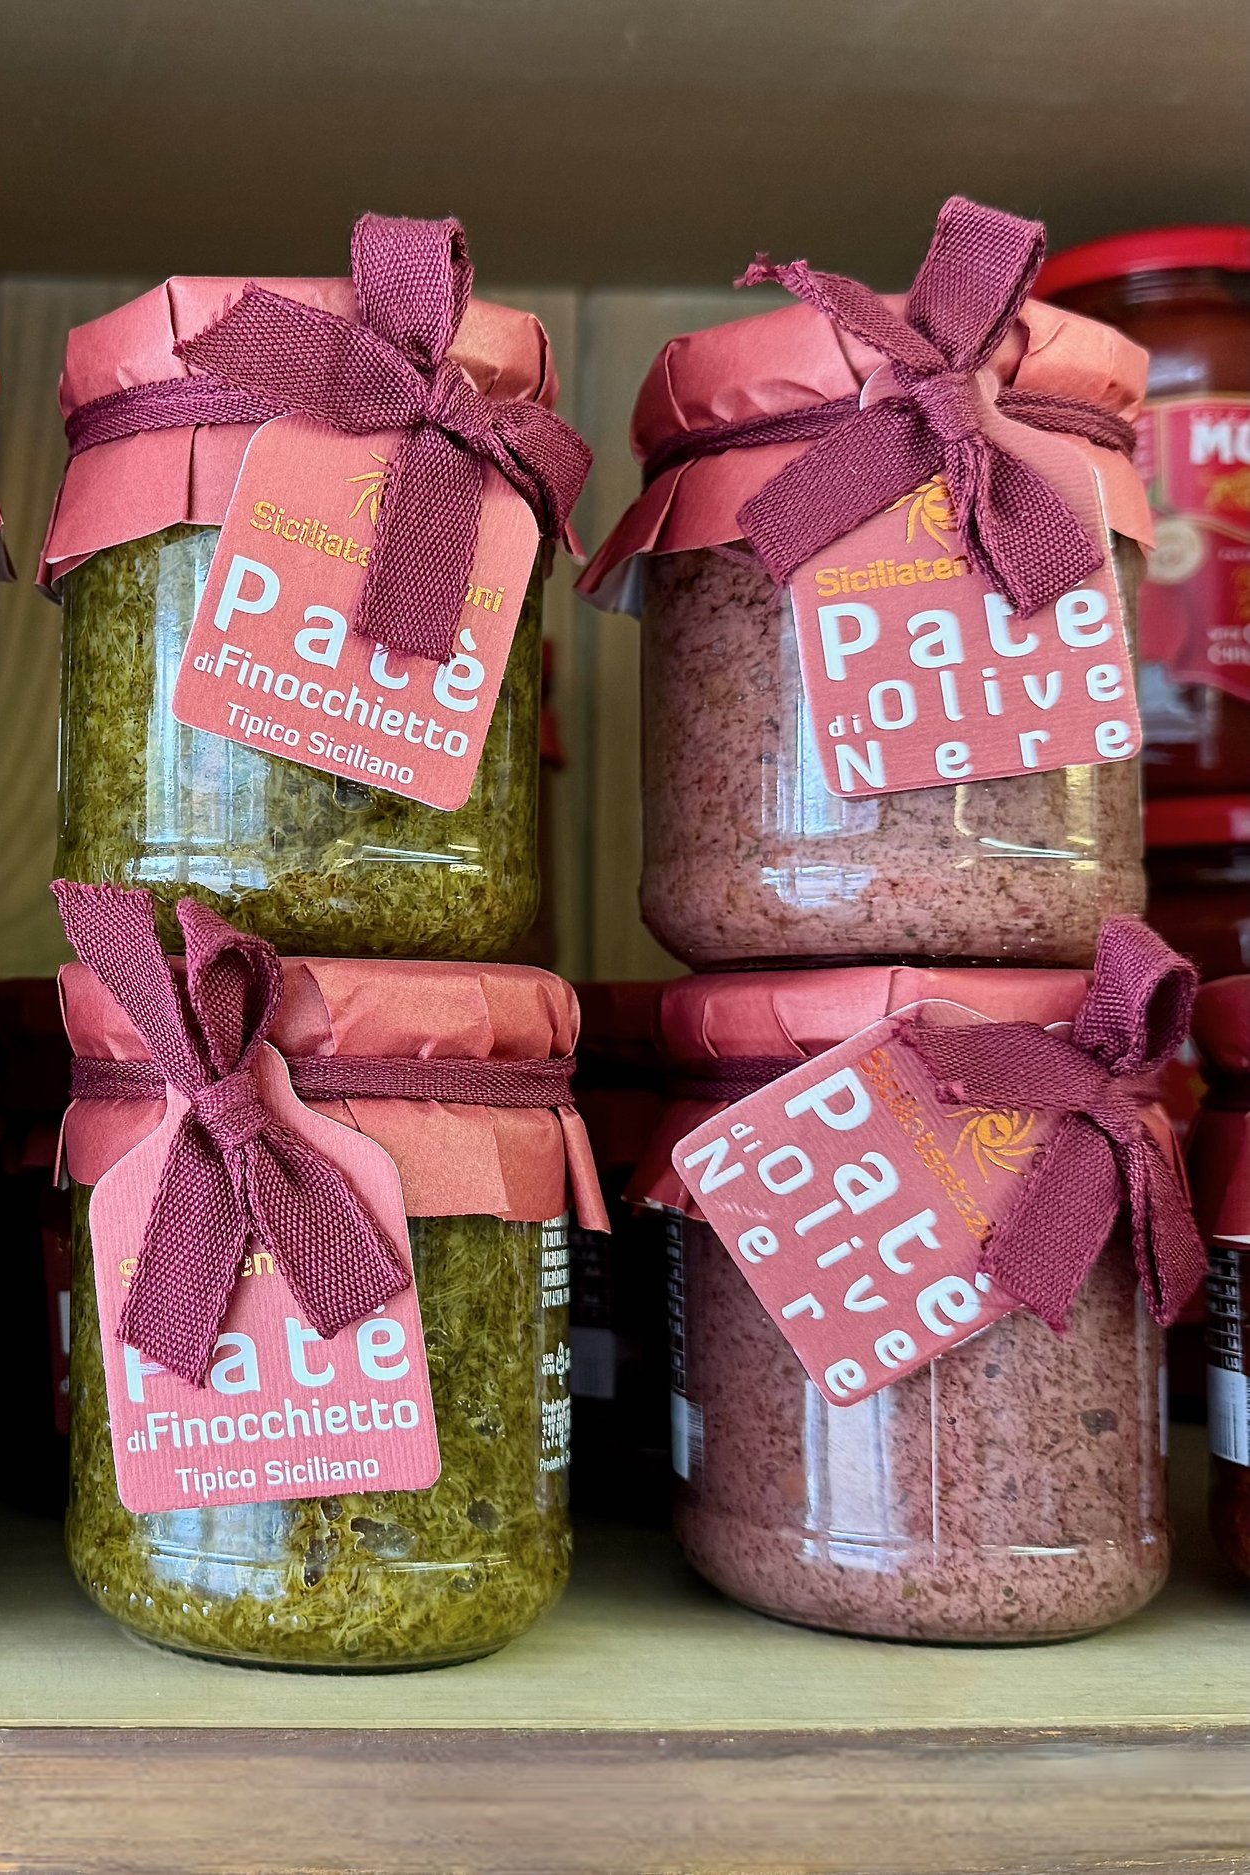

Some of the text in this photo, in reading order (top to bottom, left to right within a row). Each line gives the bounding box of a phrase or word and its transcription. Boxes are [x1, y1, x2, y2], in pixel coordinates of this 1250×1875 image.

[828, 663, 1125, 737] di Olive
[227, 702, 414, 785] Tipico Siciliano
[835, 720, 1132, 792] Nere
[683, 1135, 867, 1398] Nere
[730, 1122, 917, 1369] di Olive
[174, 1456, 380, 1499] Tipico Siciliano
